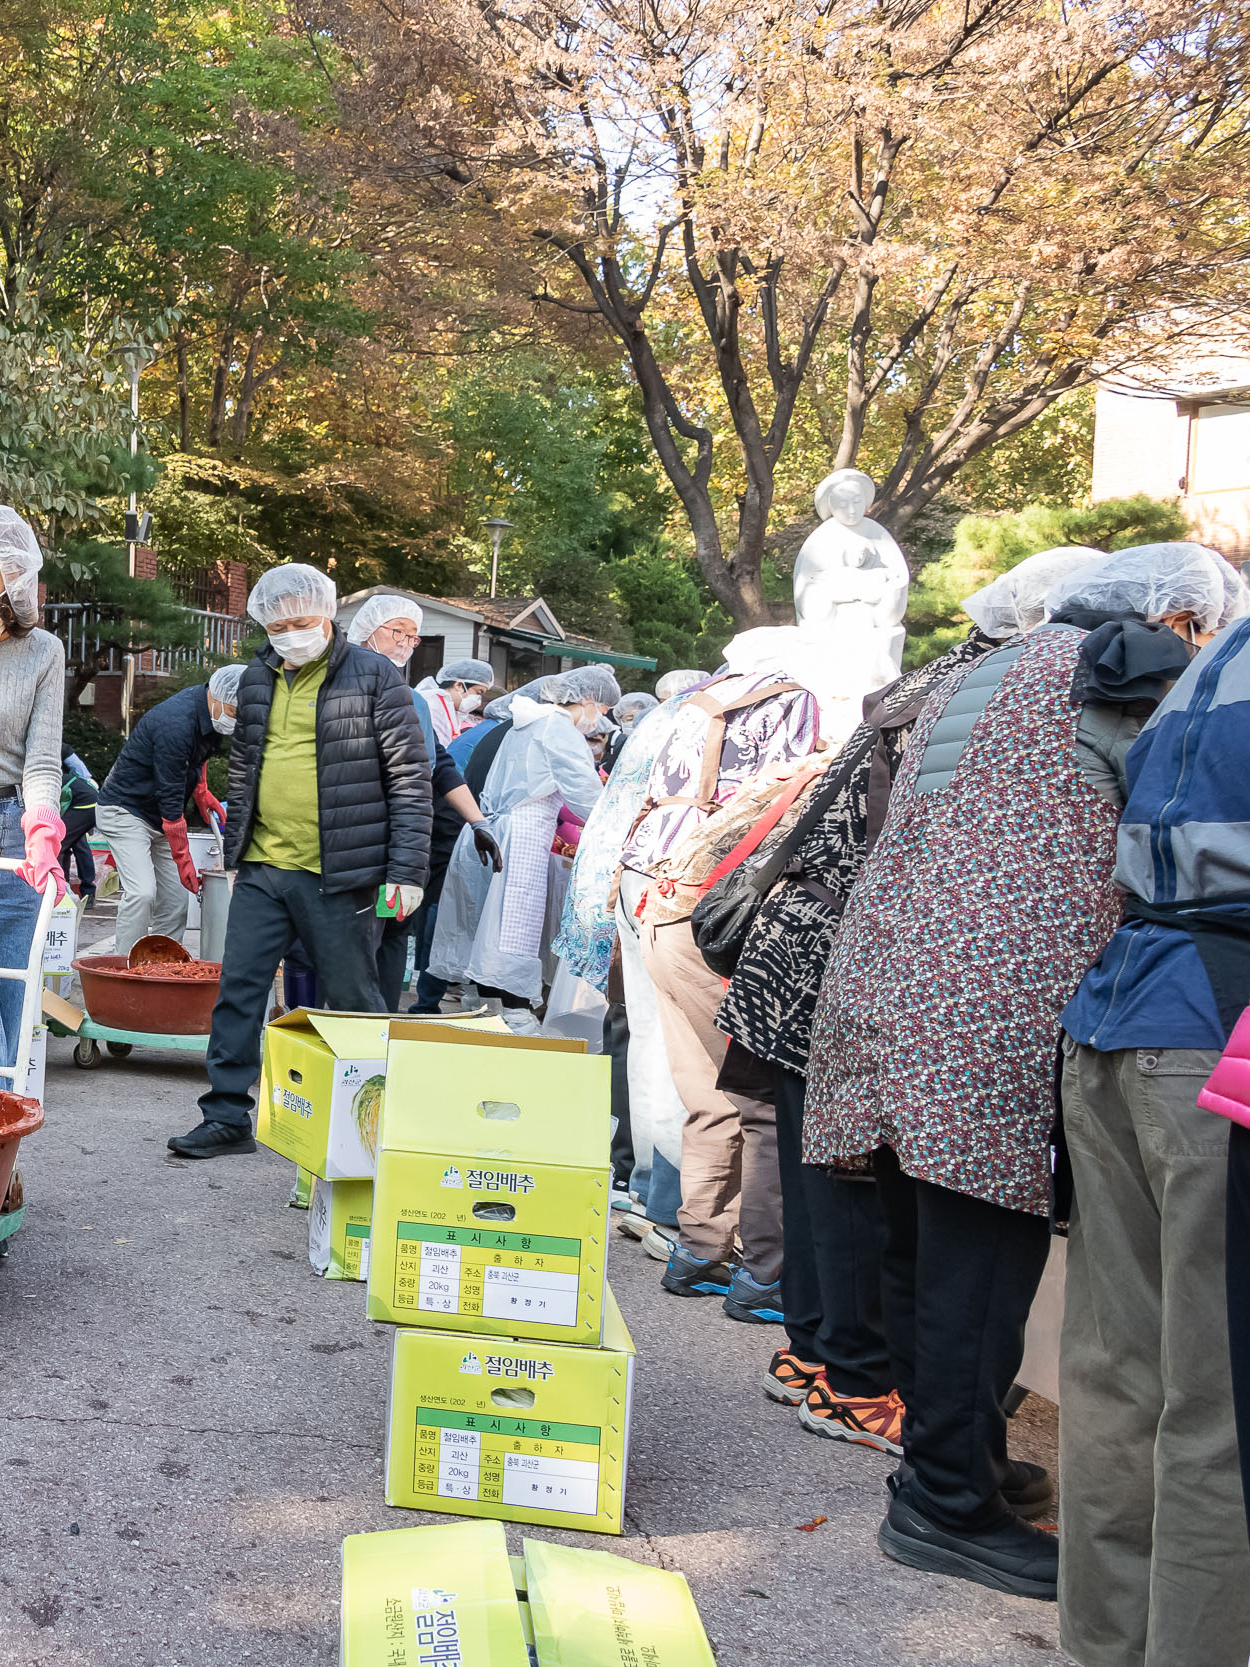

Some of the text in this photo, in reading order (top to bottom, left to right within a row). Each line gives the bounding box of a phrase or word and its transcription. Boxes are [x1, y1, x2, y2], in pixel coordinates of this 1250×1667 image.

[283, 1088, 314, 1119] 절임배추
[466, 1169, 534, 1193] 절임배추
[400, 1244, 417, 1254] 품명
[424, 1246, 458, 1258] 절임배추
[400, 1261, 416, 1271] 산지
[432, 1264, 448, 1275] 괴산
[465, 1268, 481, 1278] 주소
[398, 1277, 415, 1288] 중량
[428, 1281, 450, 1292] 20kg
[463, 1285, 480, 1295] 성명
[398, 1294, 414, 1304] 등급
[463, 1302, 479, 1311] 전화
[485, 1356, 553, 1380] 절임배추
[420, 1430, 436, 1440] 품명
[444, 1433, 477, 1445] 절임배추
[419, 1446, 436, 1456] 산지
[451, 1451, 468, 1461] 괴산
[484, 1454, 501, 1465] 주소
[418, 1463, 435, 1473] 중량
[448, 1467, 469, 1478] 20kg
[483, 1472, 500, 1482] 성명
[418, 1480, 434, 1490] 등급
[483, 1488, 499, 1498] 전화
[384, 1598, 405, 1640] 소금원산지
